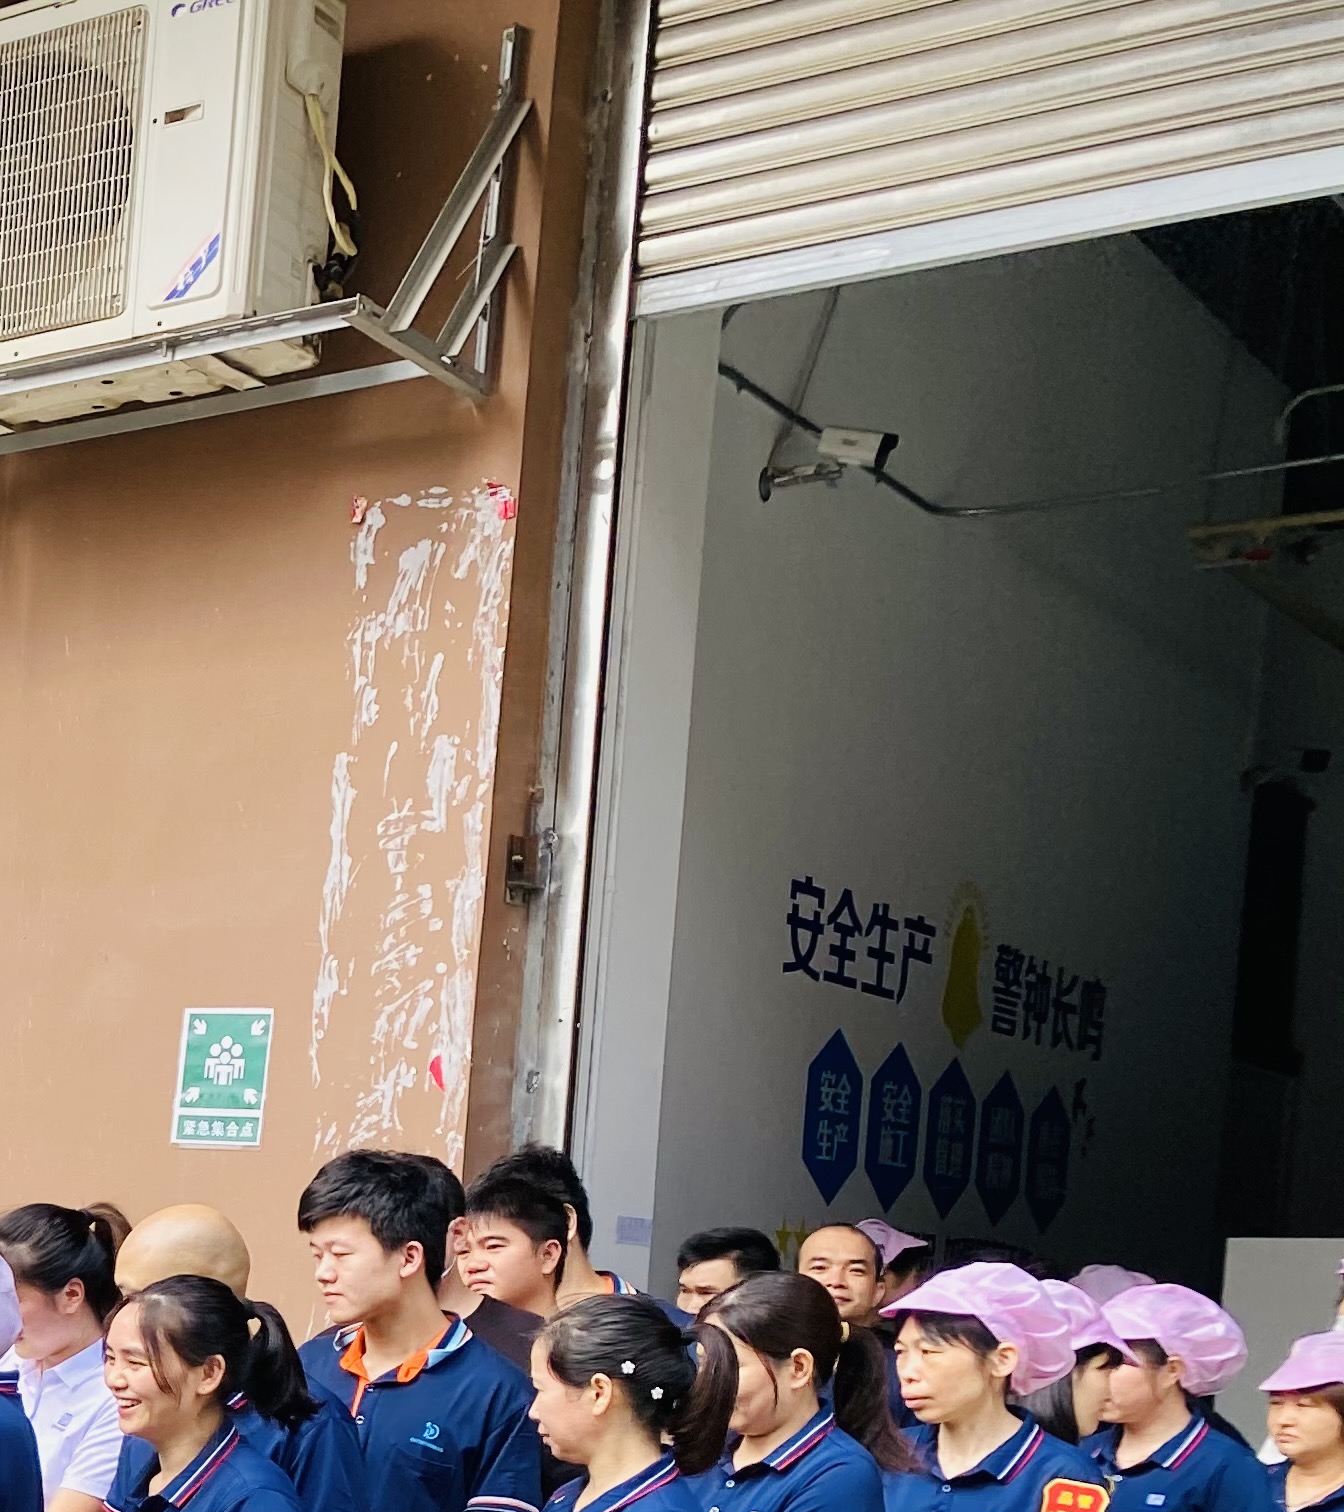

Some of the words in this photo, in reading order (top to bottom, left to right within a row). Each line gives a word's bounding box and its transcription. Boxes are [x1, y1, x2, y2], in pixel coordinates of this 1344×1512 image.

[782, 875, 937, 1005] 安全生产
[991, 943, 1108, 1062] 警钟长鸣
[820, 1069, 852, 1116] 安全
[182, 1119, 254, 1138] 紧急集合点
[815, 1119, 849, 1162] 生产
